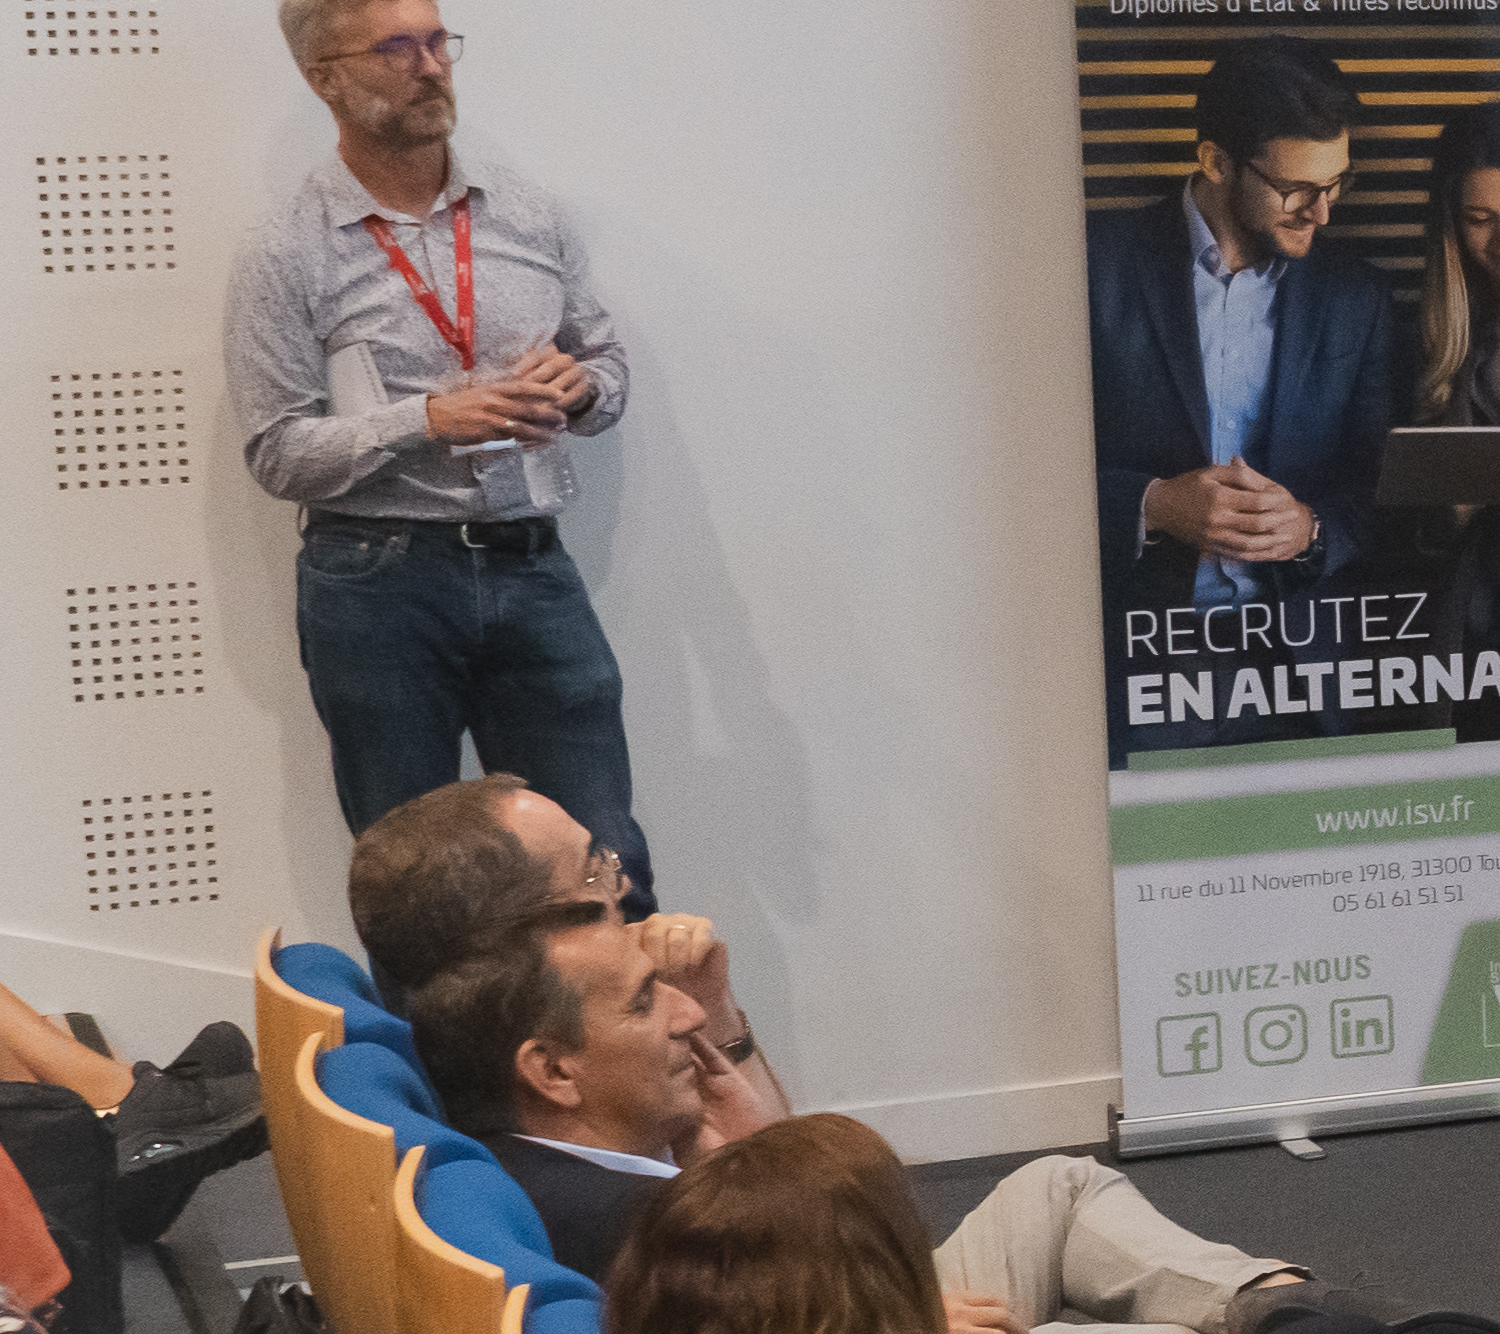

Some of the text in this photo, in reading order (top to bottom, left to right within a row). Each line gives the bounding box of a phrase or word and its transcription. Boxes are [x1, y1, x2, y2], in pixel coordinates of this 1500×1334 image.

[1125, 592, 1430, 658] RECRUTEZ
[1127, 671, 1214, 726] EN
[1315, 794, 1475, 833] www.isv.fr
[1137, 884, 1155, 902] 11
[1161, 885, 1193, 900] rue
[1200, 880, 1223, 897] du
[1229, 876, 1246, 894] 11
[1253, 869, 1353, 891] Novembre
[1359, 863, 1405, 881] 1918,
[1411, 856, 1472, 878] 31300
[1333, 884, 1465, 912] 05 61 61 51 51
[1174, 954, 1372, 998] SUIVEZ-NOUS
